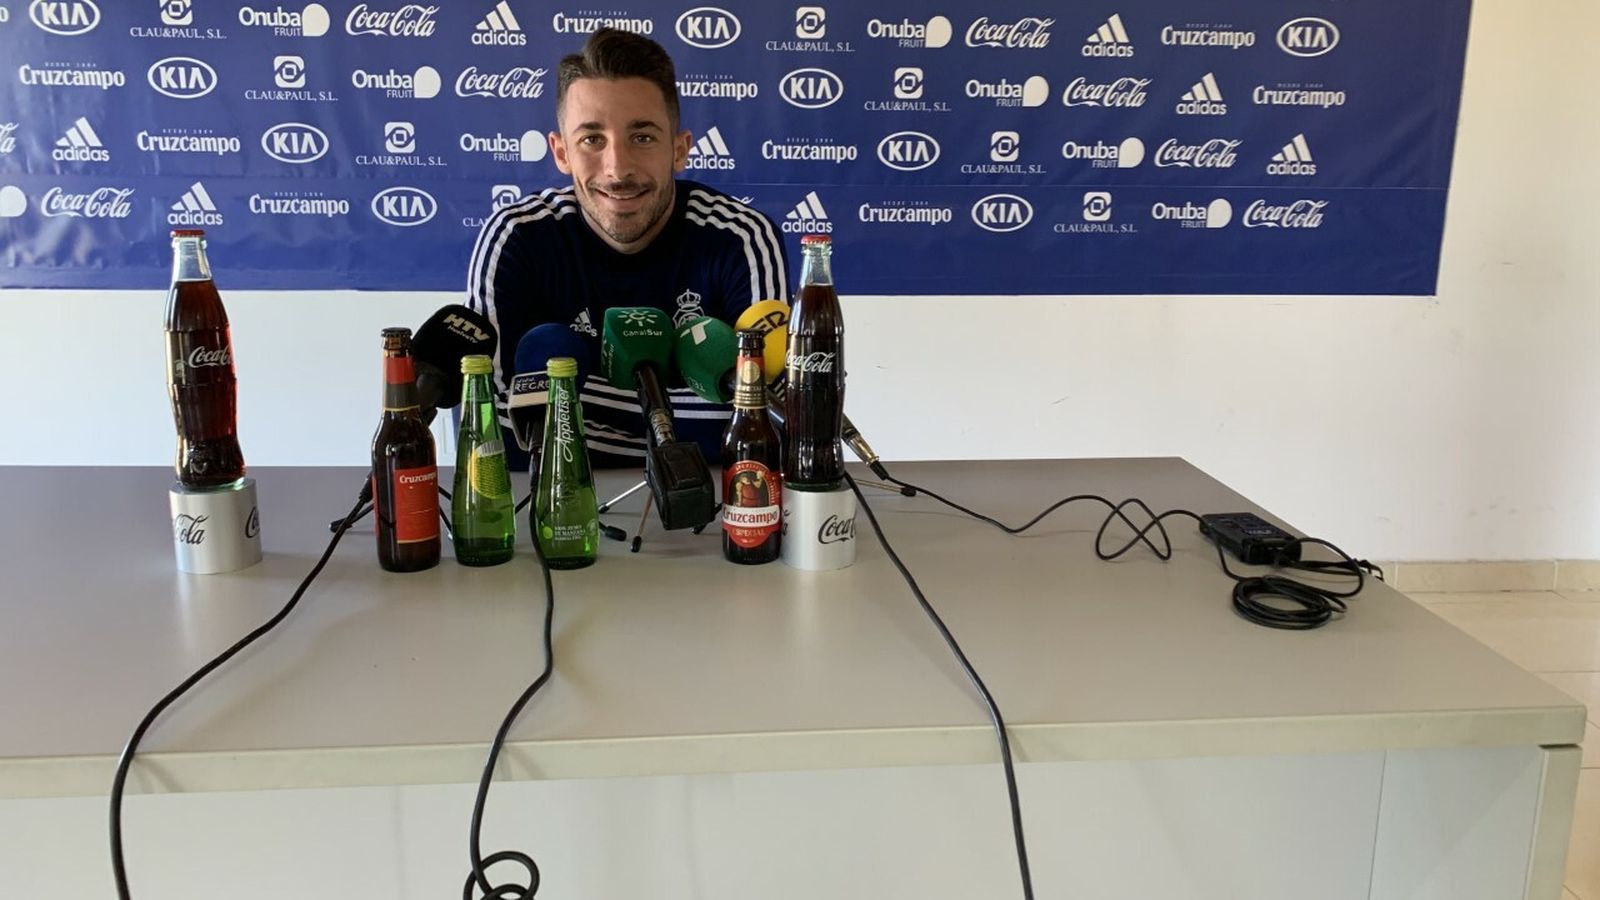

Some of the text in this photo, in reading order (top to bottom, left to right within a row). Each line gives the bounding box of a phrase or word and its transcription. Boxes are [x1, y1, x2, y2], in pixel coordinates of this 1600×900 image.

[41, 3, 90, 26] KIA
[238, 7, 301, 26] Onuba
[345, 3, 439, 36] Coca-Cola
[553, 11, 653, 34] Cruzcampo
[274, 27, 301, 36] FRUIT
[687, 17, 731, 39] KIA
[867, 19, 925, 38] Onuba
[965, 17, 1056, 48] Coca-Cola
[1161, 26, 1256, 49] Cruzcampo
[1287, 27, 1328, 47] KIA
[471, 31, 527, 46] adidas
[899, 39, 924, 48] FRUIT
[1081, 41, 1134, 57] adidas
[19, 64, 125, 90] Cruzcampo
[160, 67, 207, 89] KIA
[352, 69, 412, 89] Onuba
[454, 66, 548, 99] Coca-Cola
[386, 90, 412, 98] FRUIT
[675, 81, 758, 101] uzcampo
[790, 78, 832, 99] KIA
[965, 79, 1022, 98] Onuba
[1062, 77, 1152, 107] Coca-Cola
[1253, 85, 1346, 108] Cruzcampo
[996, 99, 1022, 107] FRUIT
[1176, 101, 1227, 115] adidas
[137, 130, 241, 155] Cruzcampo
[273, 133, 317, 154] KIA
[460, 133, 519, 152] Onuba
[762, 140, 858, 163] Cruzcampo
[888, 140, 929, 161] KIA
[1062, 141, 1117, 159] Onuba
[52, 147, 110, 161] adidas
[493, 153, 519, 161] FRUIT
[684, 155, 736, 170] adidas
[1154, 138, 1243, 168] Coca-Cola
[1266, 162, 1317, 175] adidas
[41, 187, 135, 218] Coca-Cola
[249, 193, 349, 217] Cruzcampo
[383, 197, 425, 217] KIA
[1152, 202, 1206, 220] Onuba
[168, 210, 223, 225] adidas
[859, 203, 952, 225] Cruzcampo
[982, 203, 1022, 223] KIA
[1243, 199, 1329, 228] Coca-Cola
[782, 219, 833, 233] adidas
[443, 314, 490, 341] HTV
[750, 311, 787, 337] ER
[557, 388, 574, 463] Appletiser
[724, 507, 777, 524] Cruzcampo
